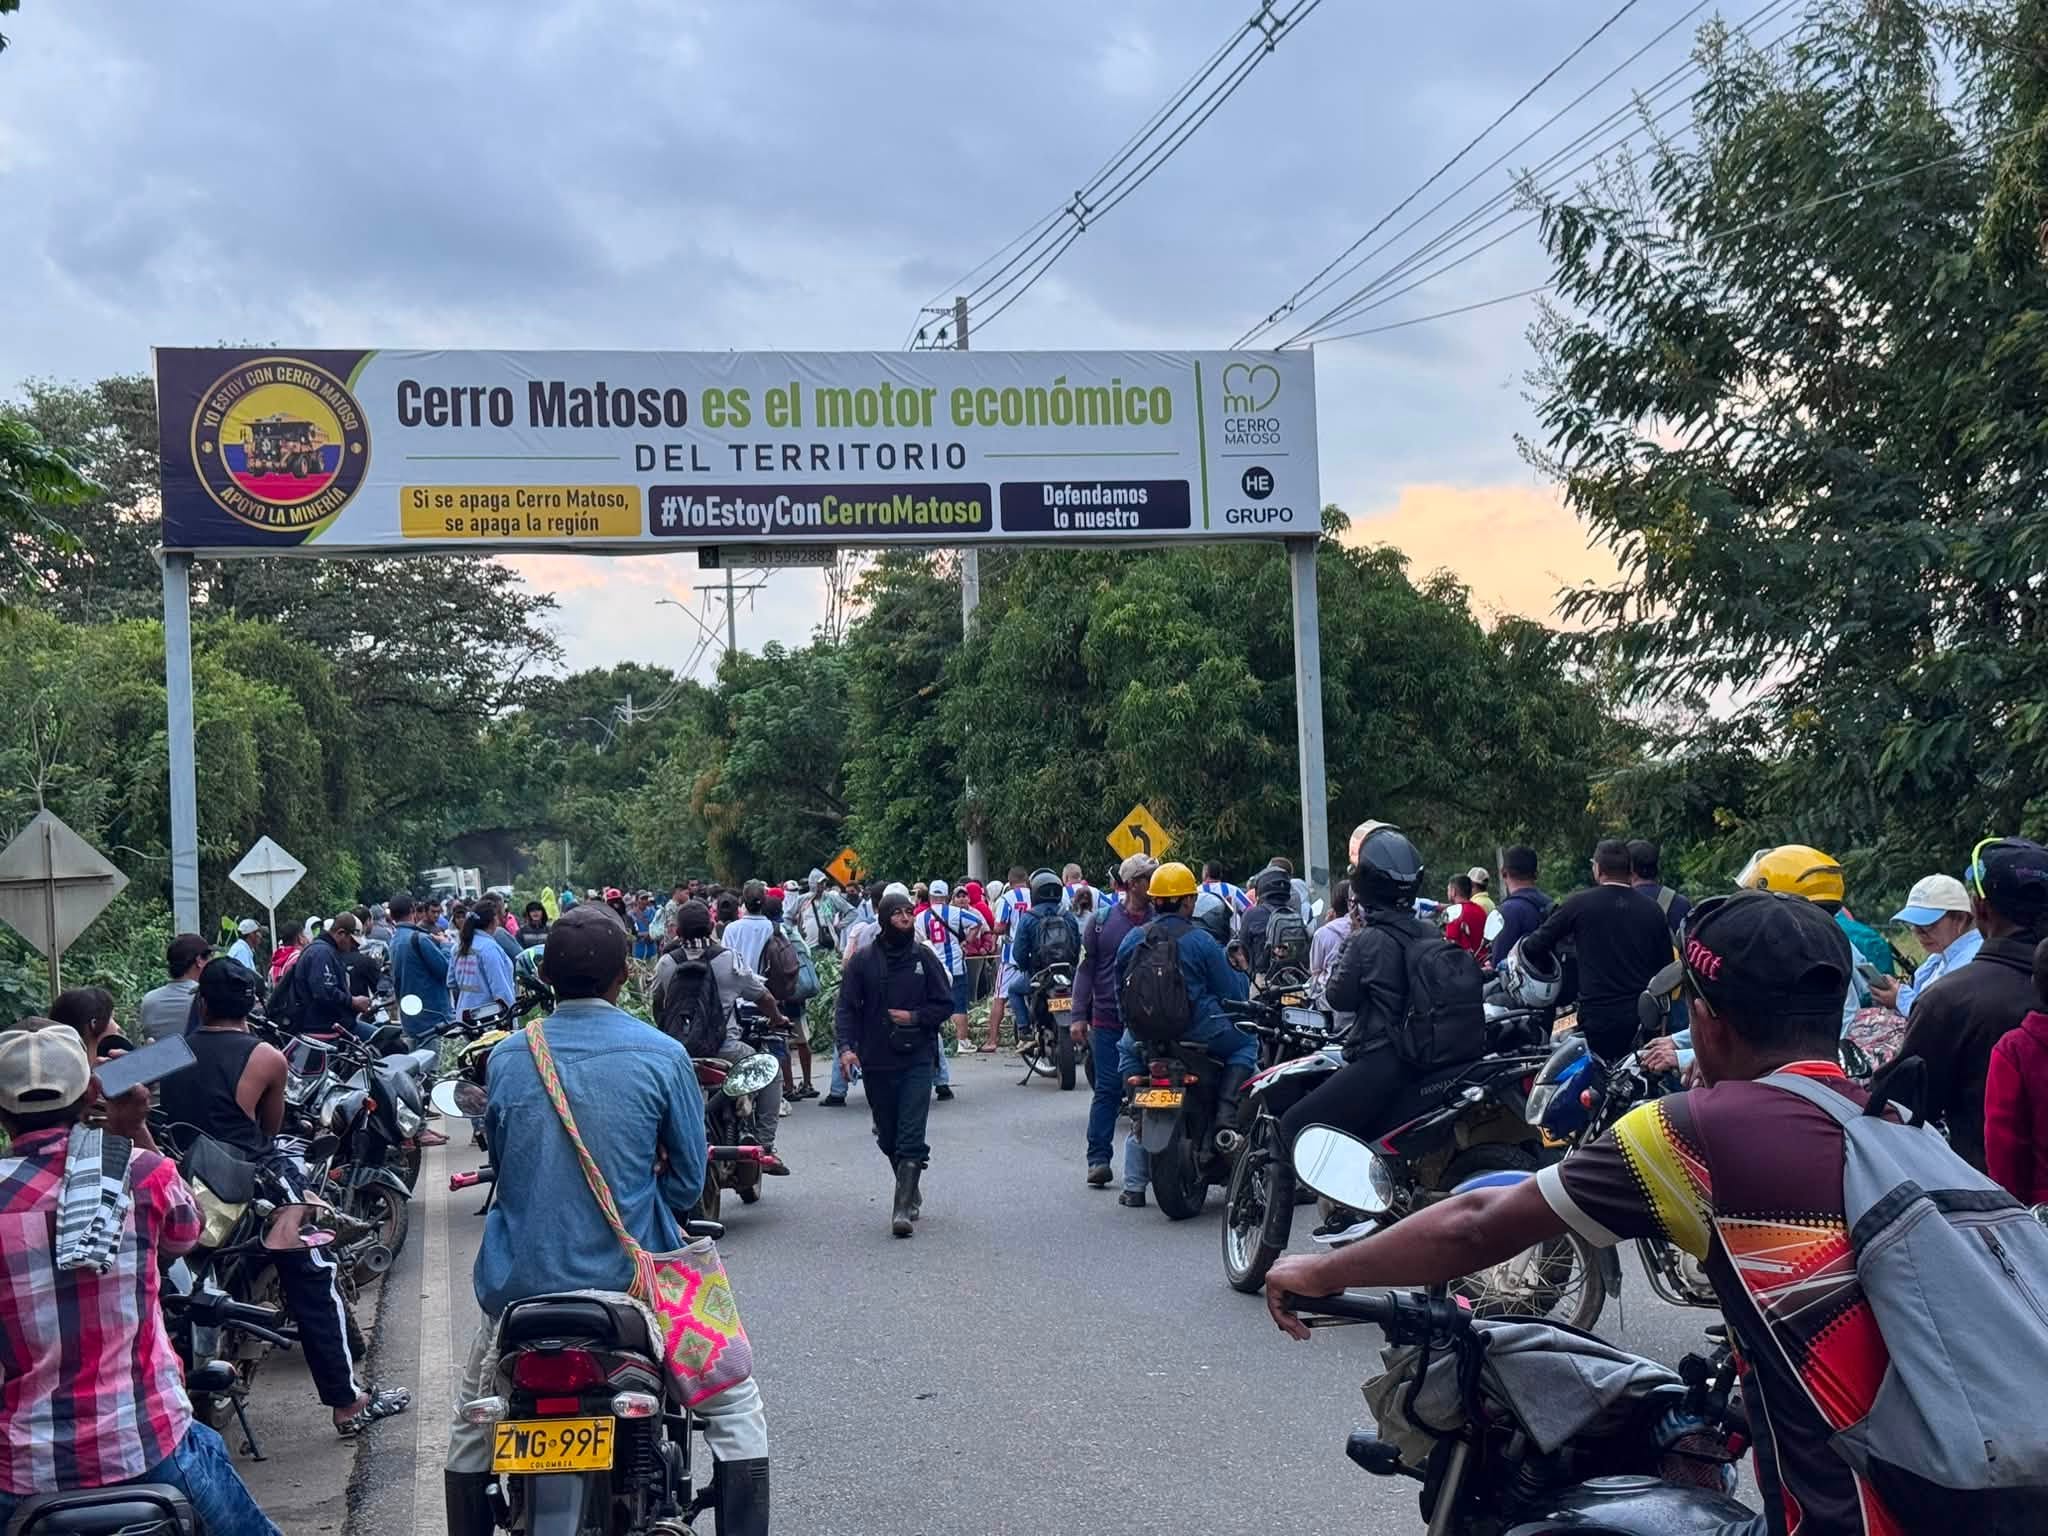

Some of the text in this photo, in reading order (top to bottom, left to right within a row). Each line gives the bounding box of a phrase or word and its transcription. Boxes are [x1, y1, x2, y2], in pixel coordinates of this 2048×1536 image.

[203, 366, 359, 431] YO ESTOY CON CERRO MATOSO
[397, 375, 1173, 428] Cerro Matoso es el motor económico
[1225, 418, 1280, 433] CERRO
[1225, 433, 1281, 445] MATOSO
[635, 443, 966, 472] DEL TERRITORIO
[1043, 484, 1148, 506] Defendamos
[1246, 476, 1270, 491] HE
[219, 485, 348, 524] APOYO LA MINERÍA
[413, 489, 629, 512] Si se apaga Cerro Matoso,
[445, 511, 599, 536] se apaga la región
[661, 494, 982, 533] #YoEstoyConCerroMatoso
[1053, 507, 1139, 528] lo nuestro
[1226, 508, 1293, 524] GRUPO
[560, 1427, 609, 1457] 99F
[530, 1460, 572, 1469] COLOMBIA
